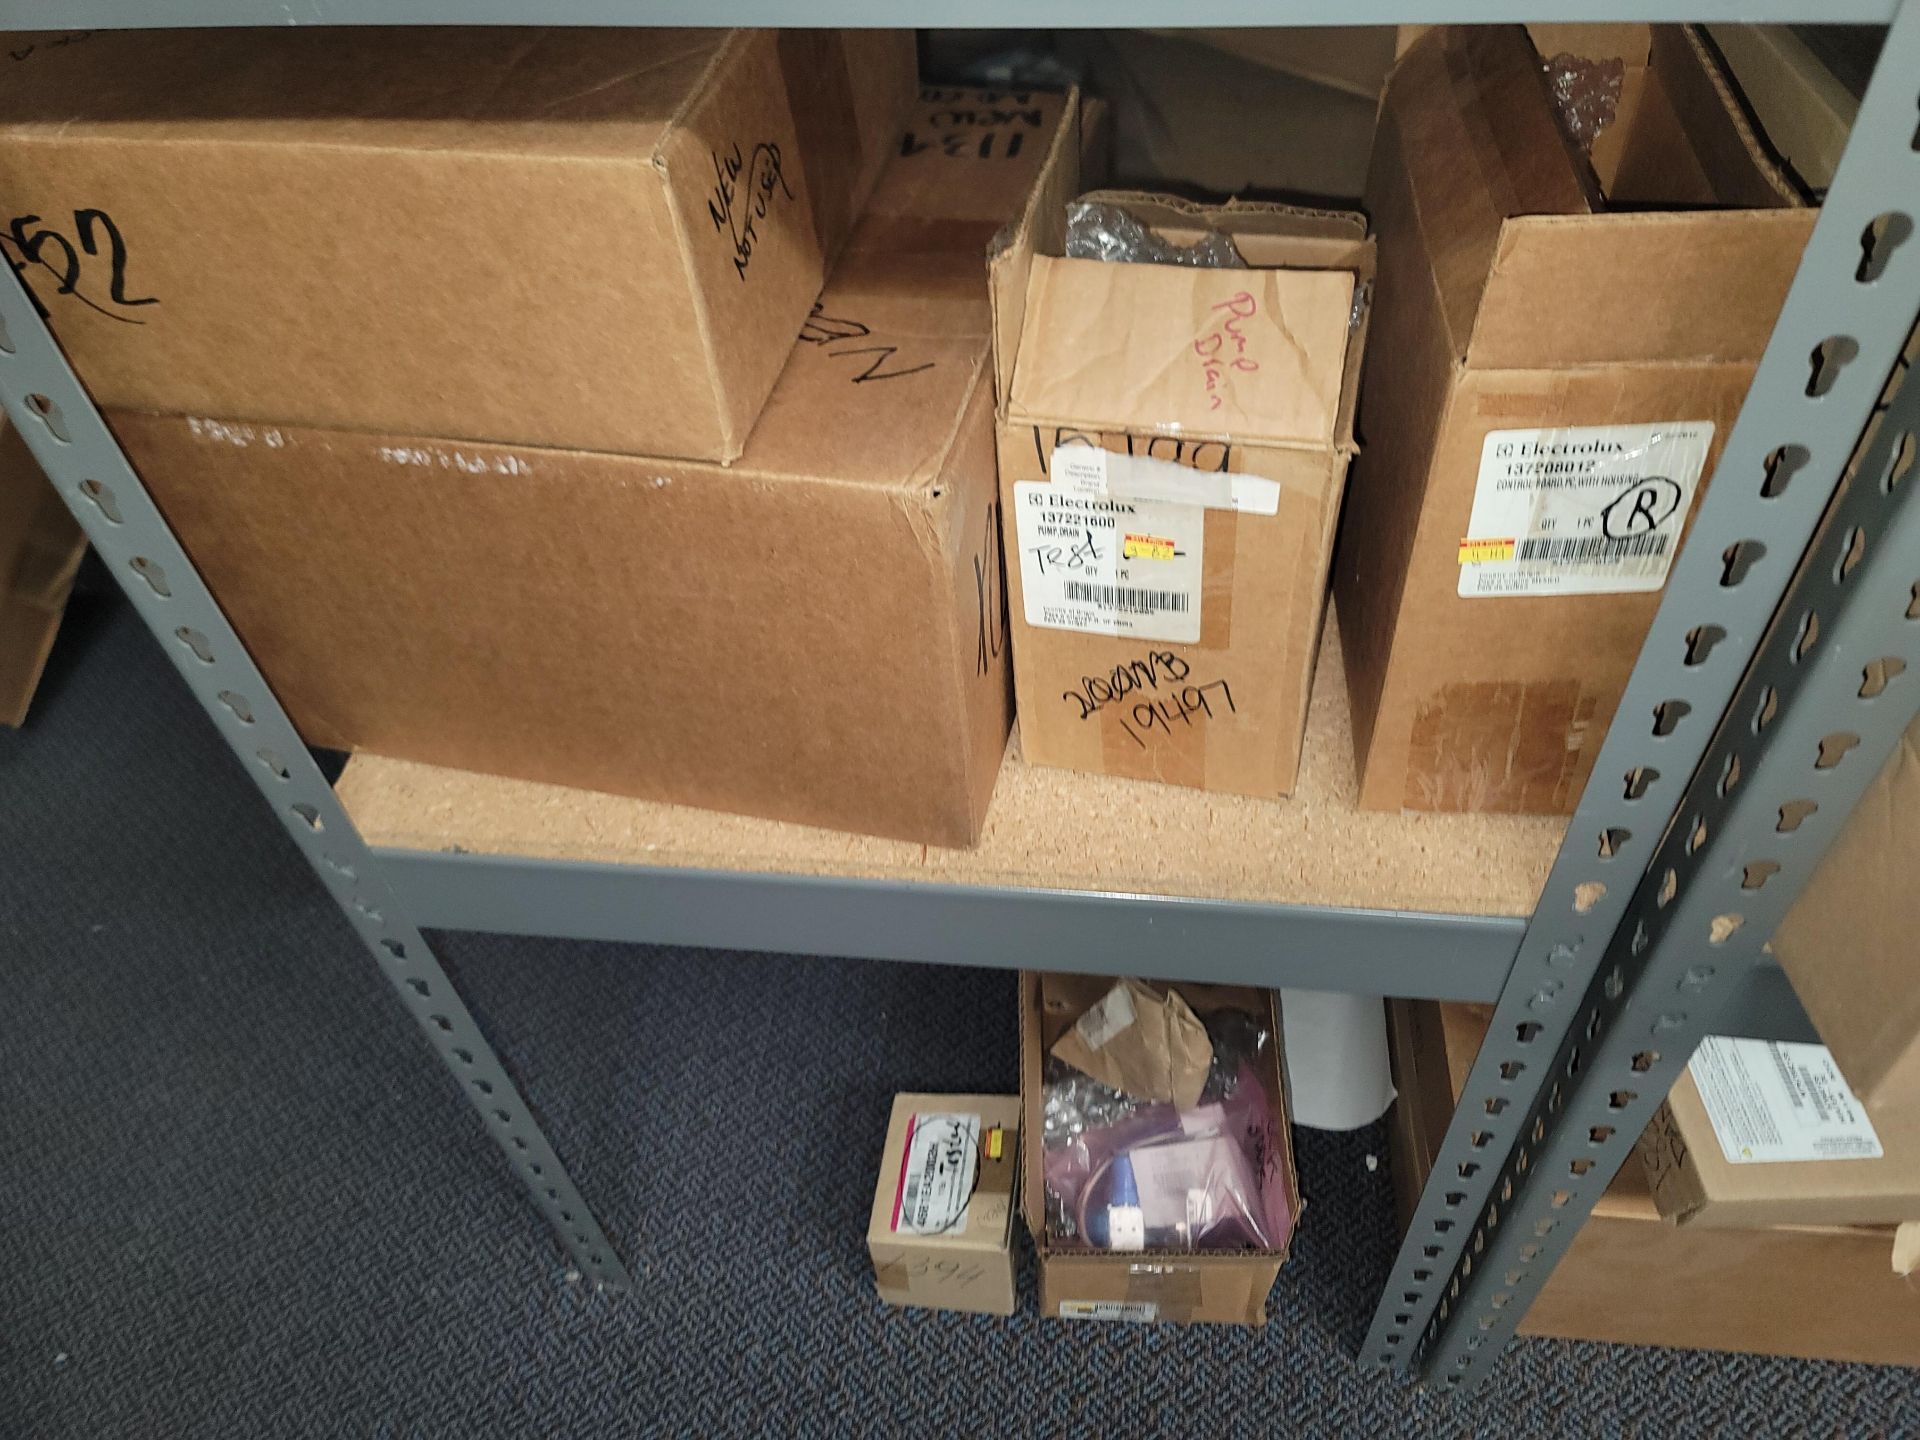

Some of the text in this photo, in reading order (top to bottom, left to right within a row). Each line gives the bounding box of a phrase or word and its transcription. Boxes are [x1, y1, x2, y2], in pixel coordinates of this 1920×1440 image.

[708, 142, 742, 233] NEW
[1520, 437, 1625, 457] Electrolux
[1049, 492, 1136, 514] Electrolux
[1627, 489, 1657, 530] R
[1040, 511, 1115, 529] 137221600
[1120, 679, 1236, 749] 19497
